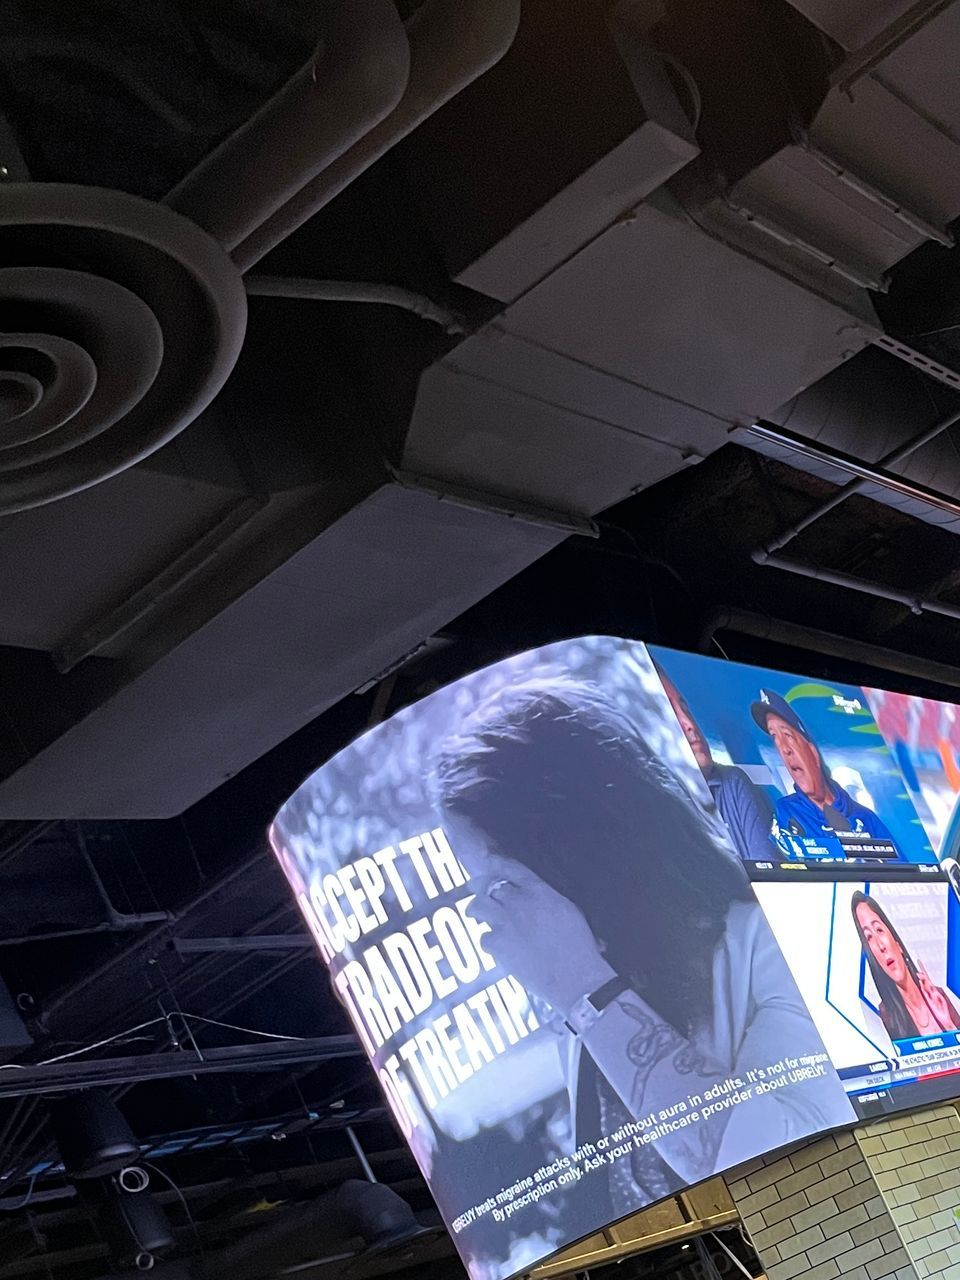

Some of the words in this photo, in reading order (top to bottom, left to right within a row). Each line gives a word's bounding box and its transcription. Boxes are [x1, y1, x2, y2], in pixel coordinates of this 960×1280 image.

[299, 845, 414, 965] ACCEPT
[399, 826, 471, 900] TH
[379, 1053, 419, 1139] OF
[474, 1197, 498, 1217] treats
[495, 1178, 534, 1205] migraine
[533, 1157, 571, 1183] attacks
[571, 1143, 597, 1163] with
[596, 1136, 610, 1150] or
[611, 1113, 658, 1143] without
[658, 1101, 688, 1121] aura
[686, 1095, 703, 1108] in
[703, 1078, 747, 1101] adults.
[746, 1068, 767, 1083] It's
[766, 1060, 787, 1077] not
[784, 1057, 800, 1070] for
[491, 1207, 506, 1222] By
[503, 1179, 559, 1218] prescription
[557, 1166, 584, 1185] only.
[584, 1153, 607, 1173] Ask
[605, 1141, 633, 1164] your
[632, 1111, 700, 1148] healthcare
[700, 1088, 753, 1121] provider
[754, 1074, 789, 1096] about
